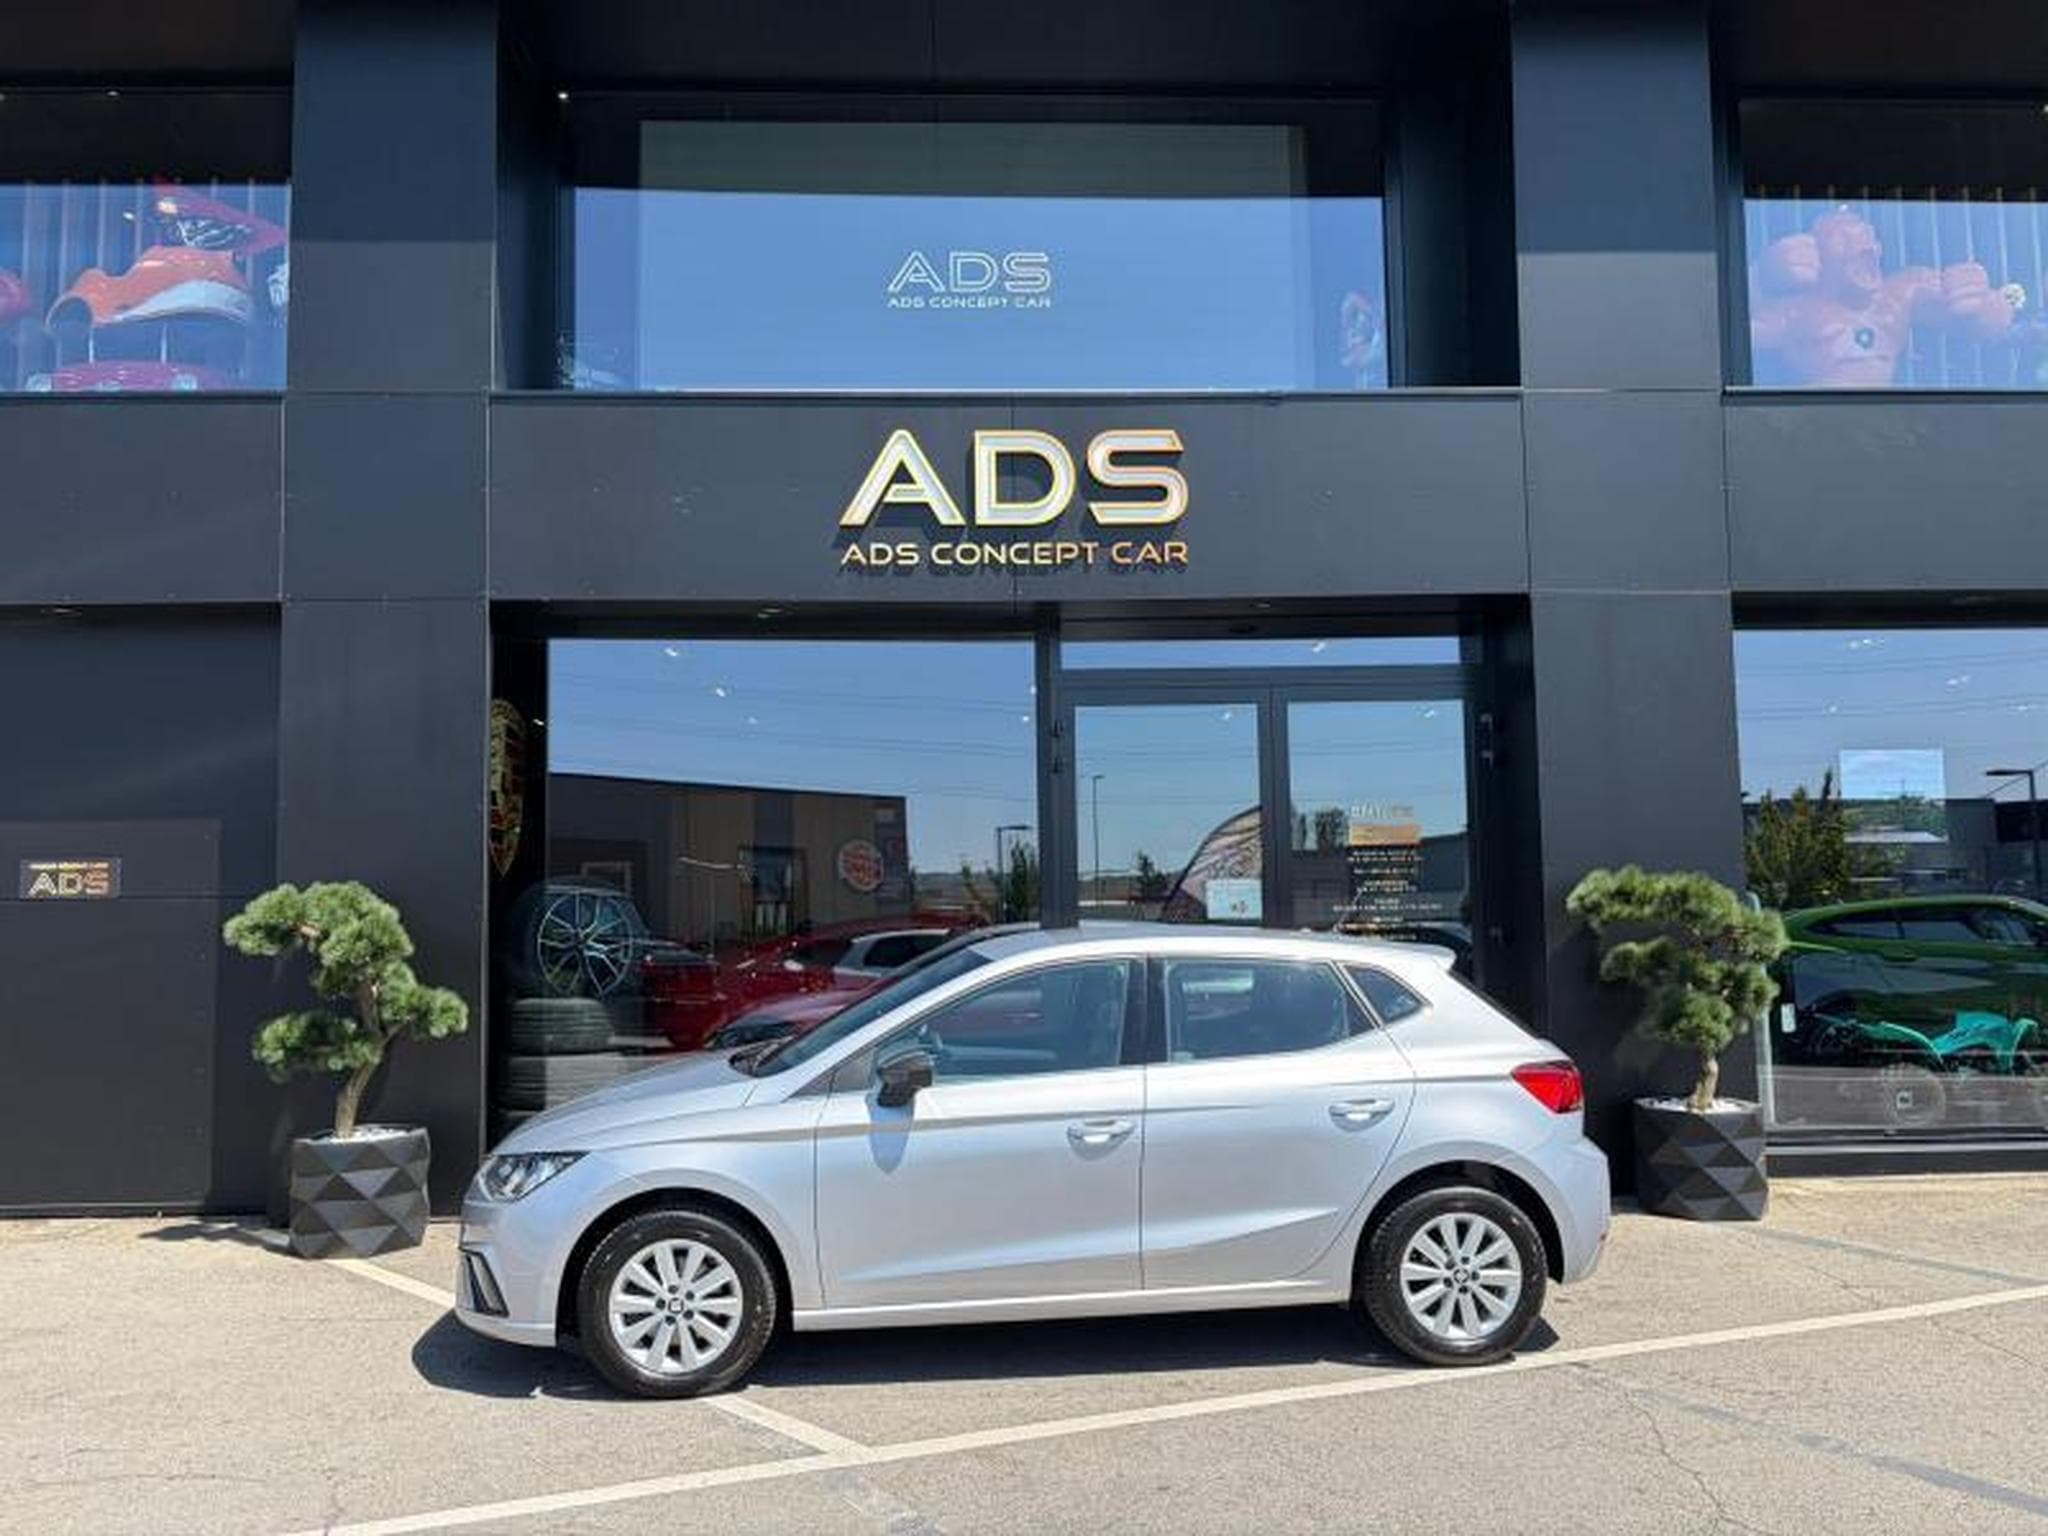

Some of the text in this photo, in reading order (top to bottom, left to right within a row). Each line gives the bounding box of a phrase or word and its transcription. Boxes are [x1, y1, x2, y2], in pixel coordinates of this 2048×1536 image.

[888, 251, 1050, 292] ADS
[887, 296, 925, 308] ADS
[929, 296, 1008, 308] CONCEPT
[840, 428, 1189, 526] ADS
[841, 541, 1189, 565] ADS CONCEPT CAR
[28, 872, 109, 896] ADS
